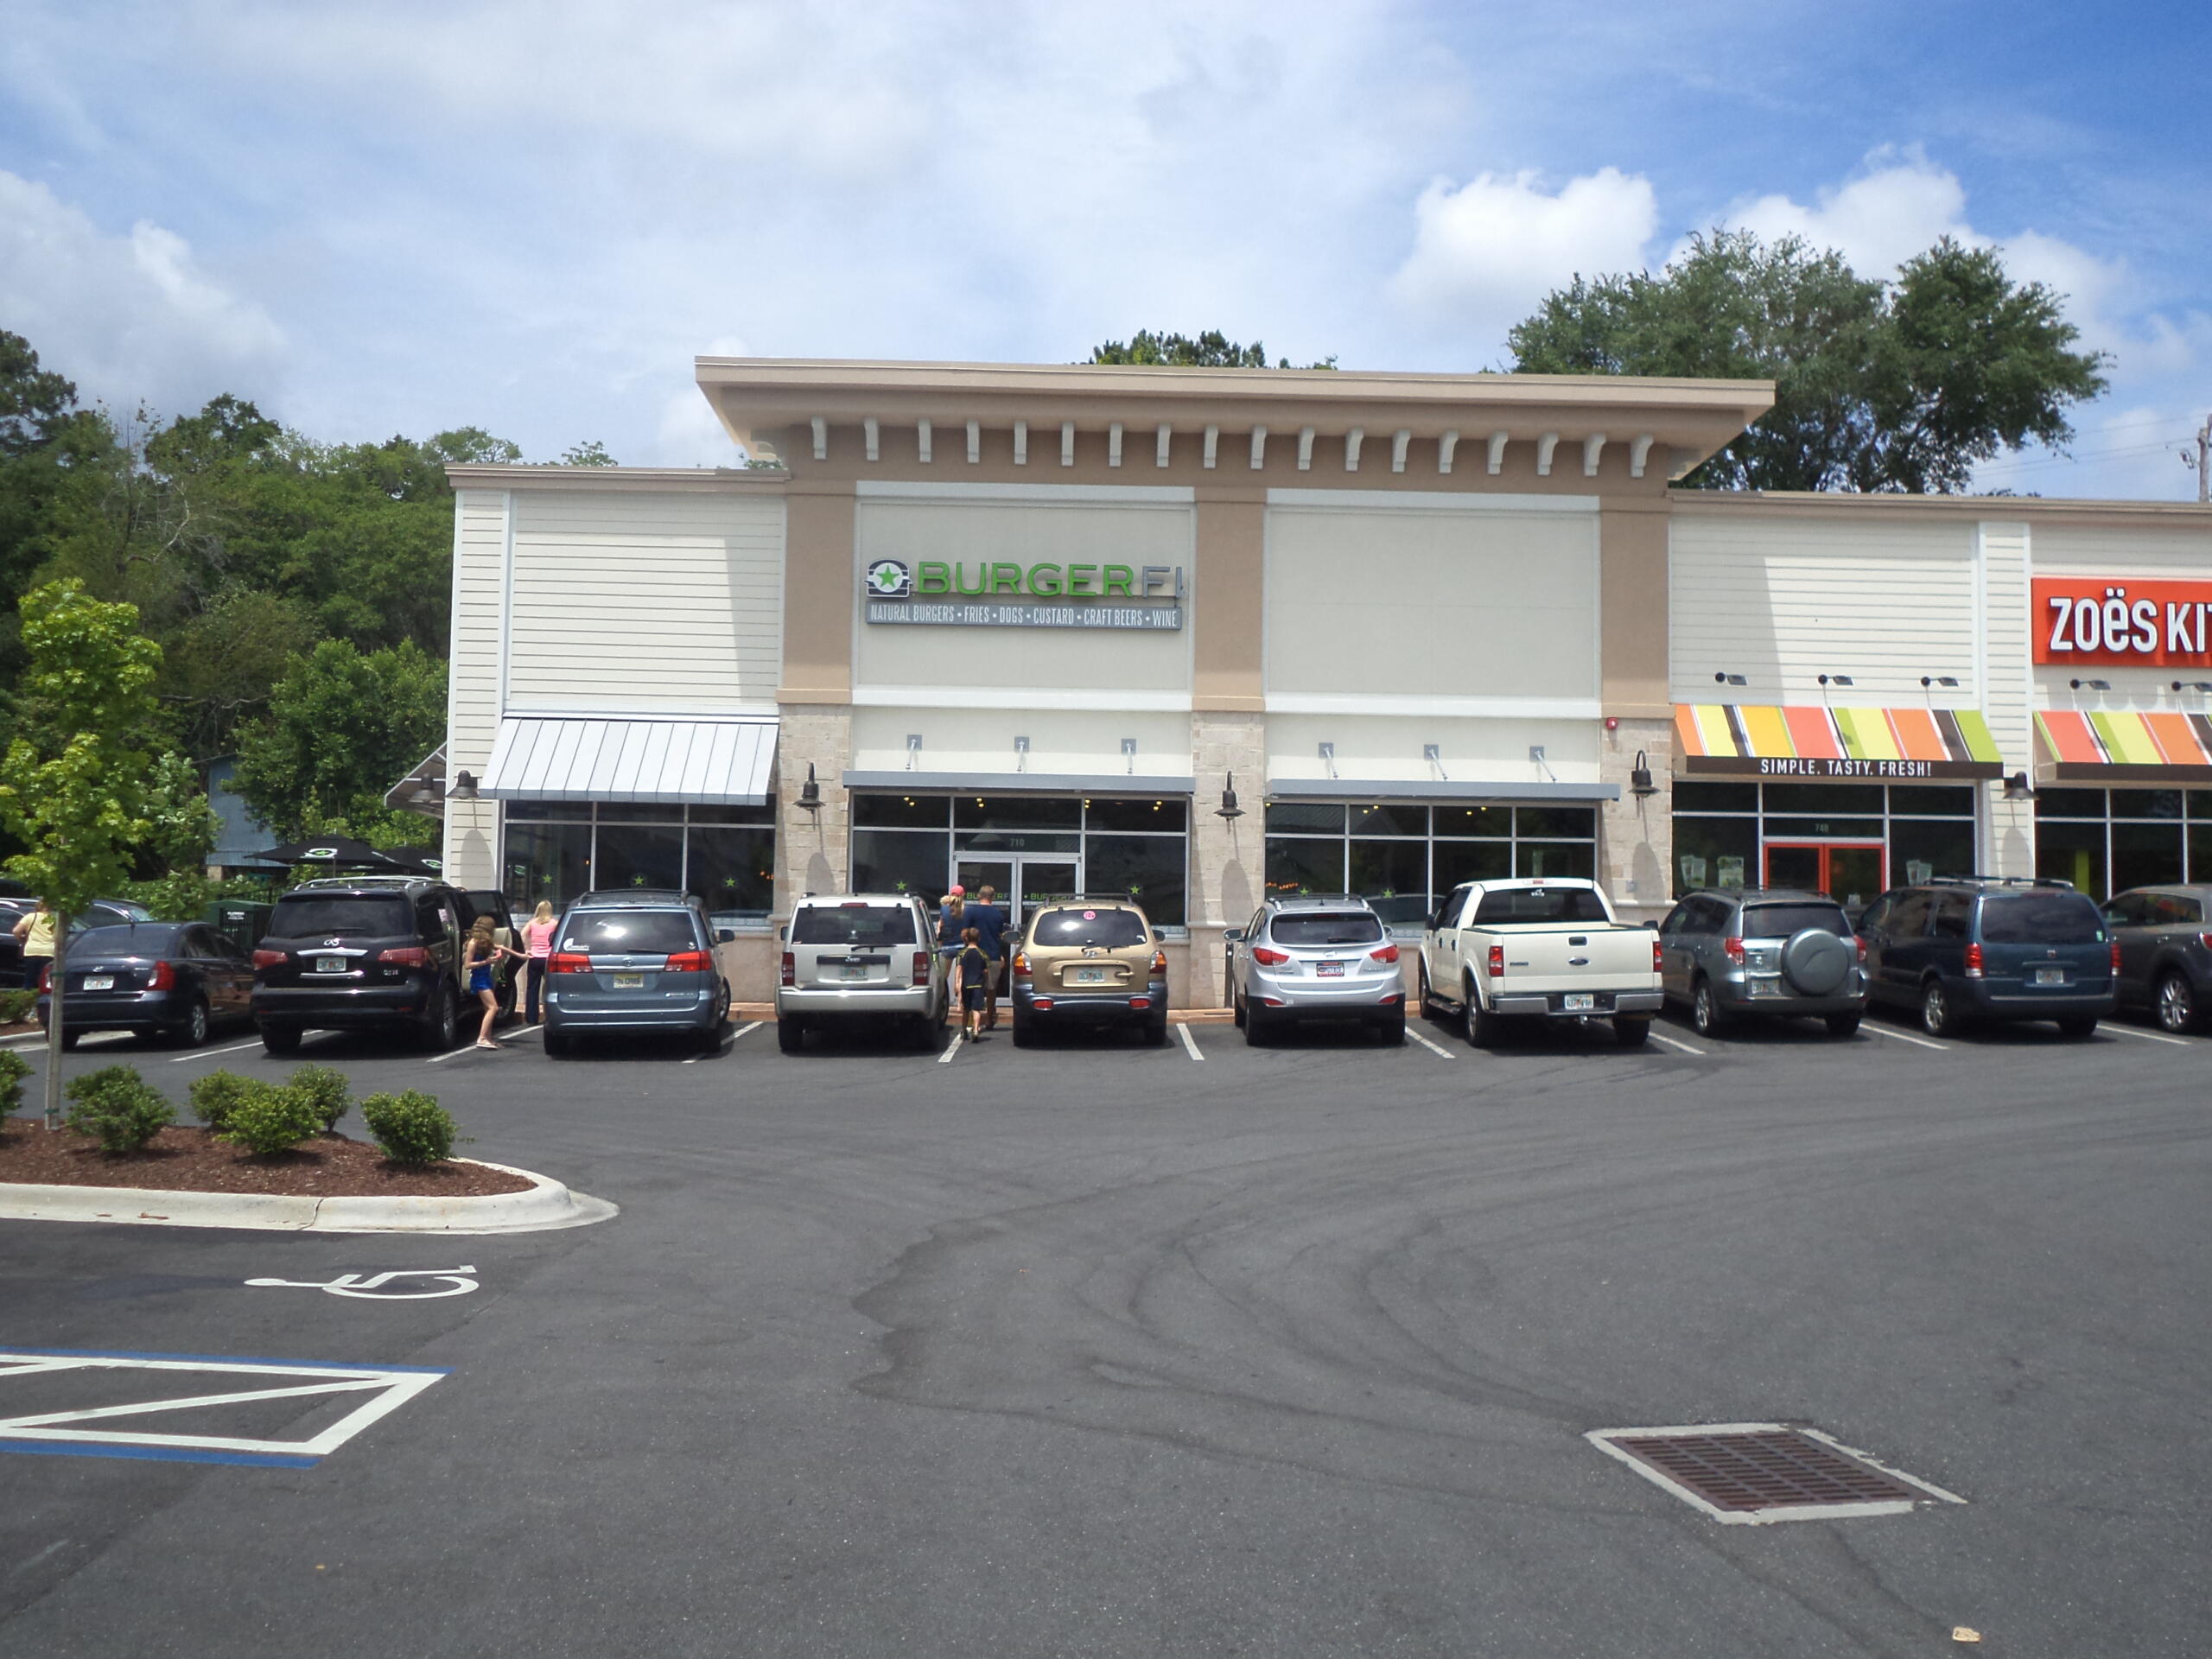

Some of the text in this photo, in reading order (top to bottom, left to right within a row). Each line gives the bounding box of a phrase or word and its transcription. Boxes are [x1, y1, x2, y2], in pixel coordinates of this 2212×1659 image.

[870, 604, 1177, 627] NATURAL BURGERS FRIES DOGS CUSTARD CRAFT BEERS WINE
[2166, 602, 2212, 653] KI
[1761, 758, 1932, 777] SIMPLE. TASTY. FRESH!
